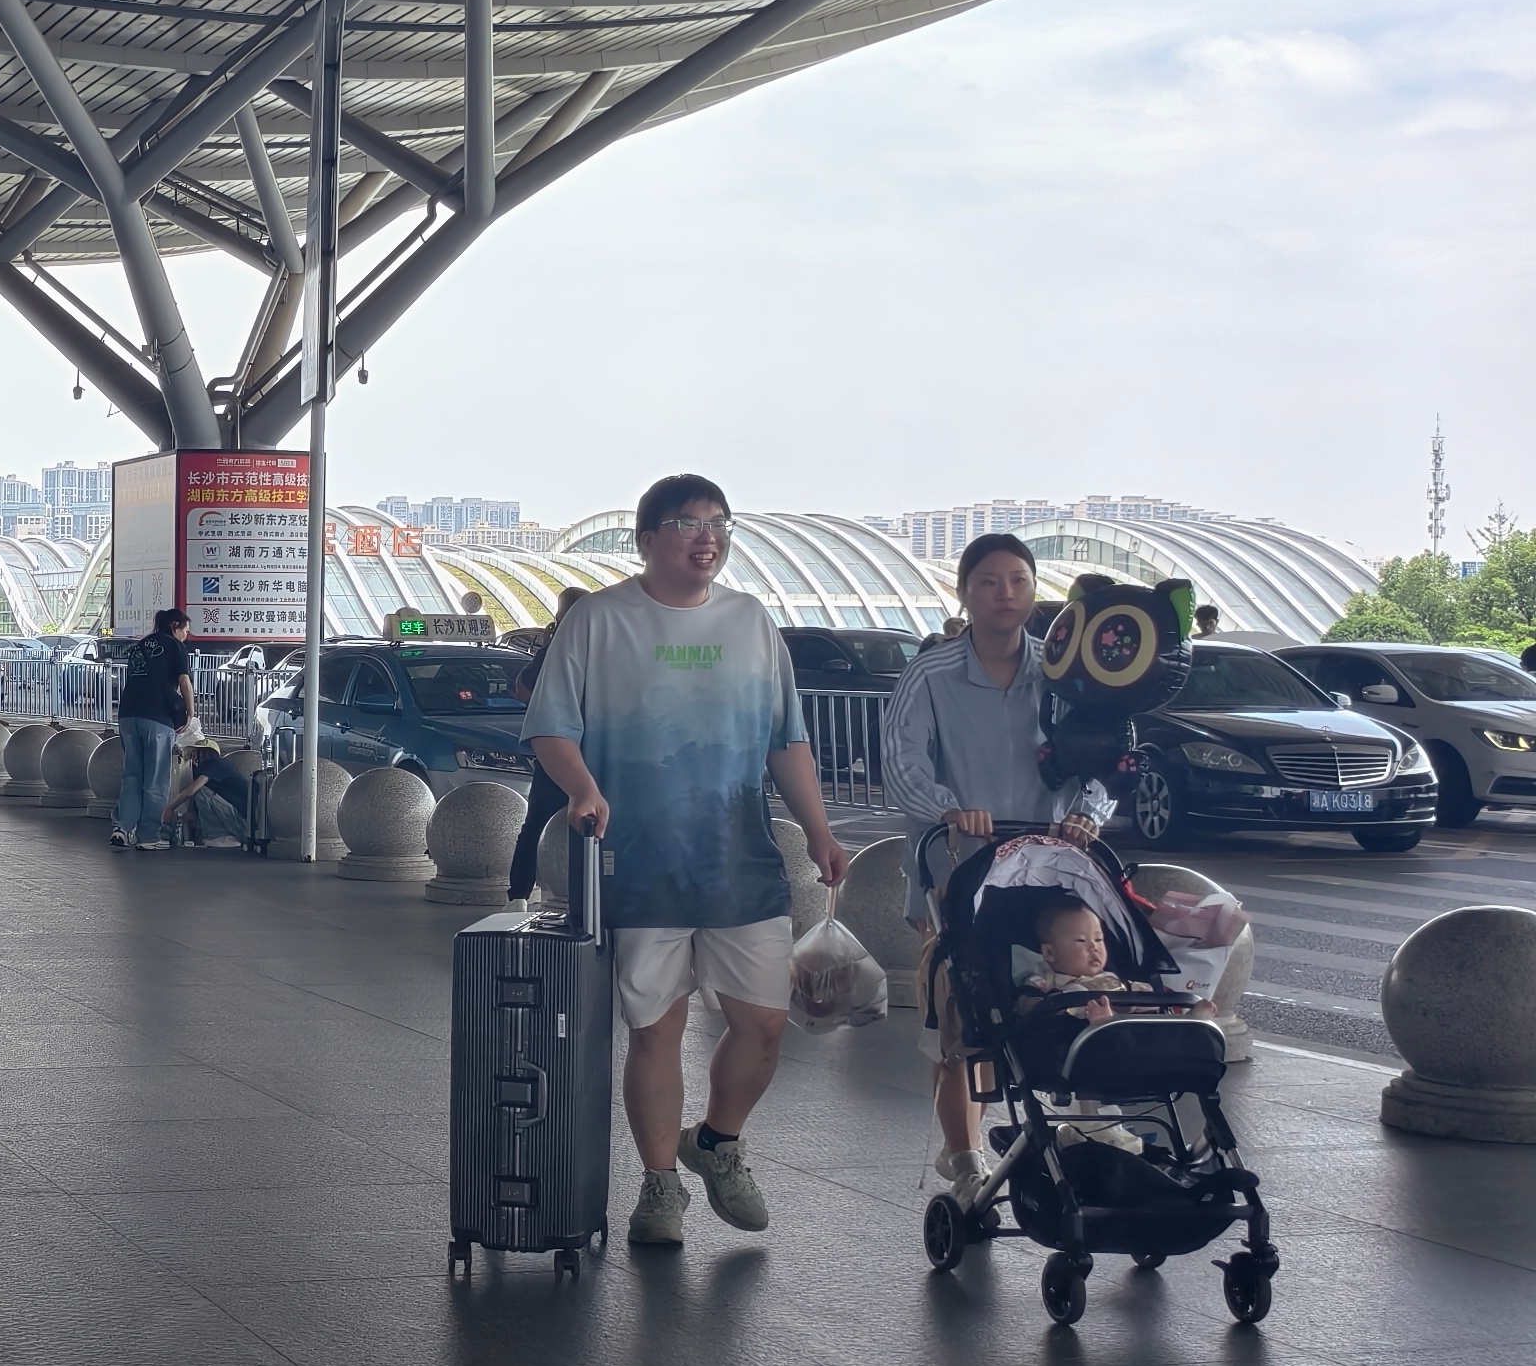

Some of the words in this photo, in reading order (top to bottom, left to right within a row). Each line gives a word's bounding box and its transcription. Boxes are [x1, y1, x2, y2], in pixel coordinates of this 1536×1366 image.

[187, 471, 309, 486] 长沙市示范性高级技
[187, 488, 309, 504] 湖南东方高级技工学
[401, 620, 425, 635] 空车
[433, 619, 491, 636] 长沙欢迎您
[655, 644, 722, 662] PANMAX
